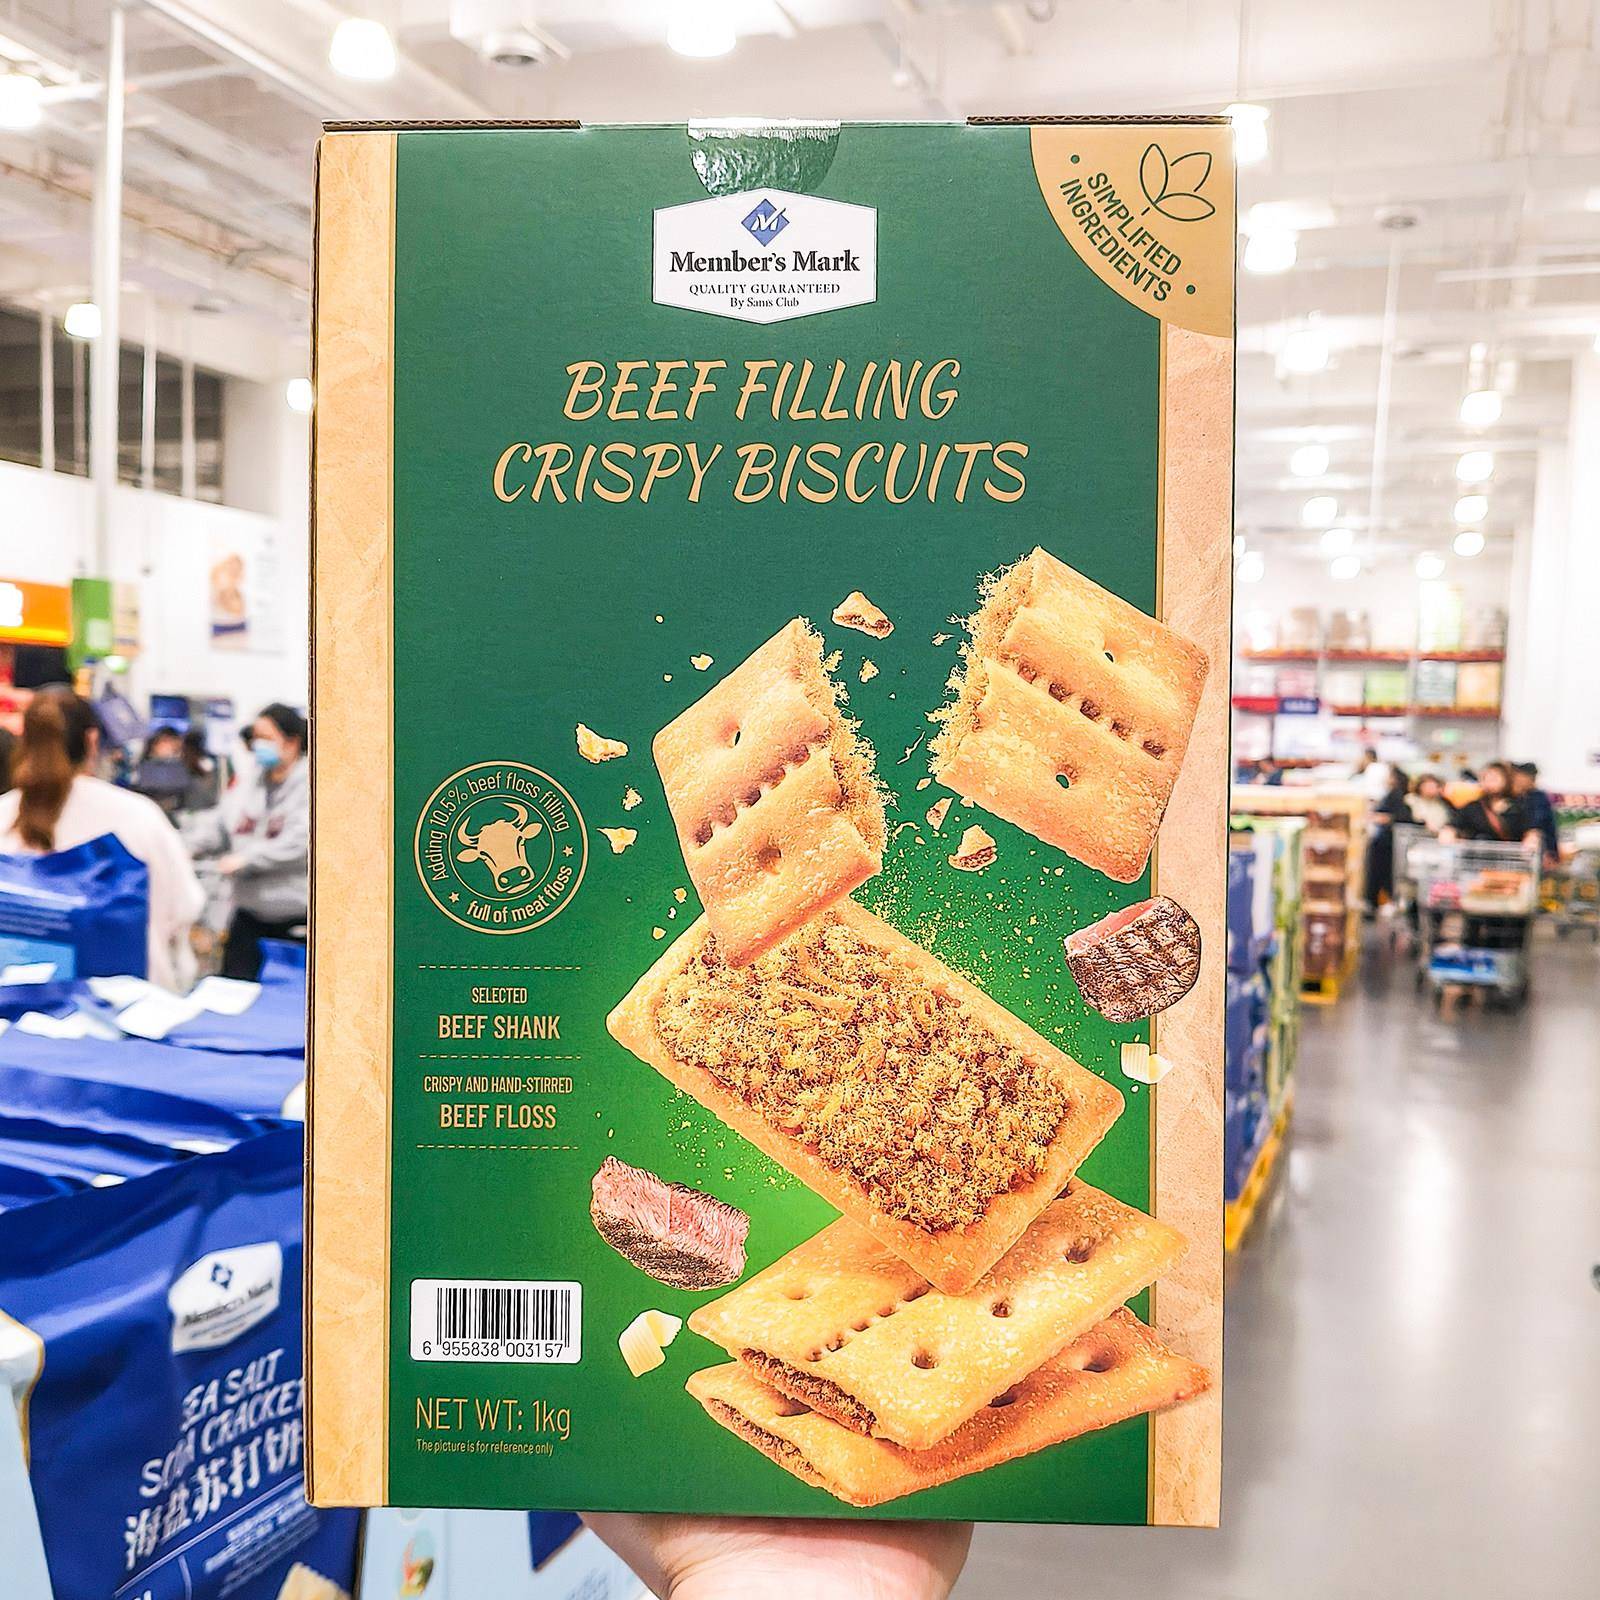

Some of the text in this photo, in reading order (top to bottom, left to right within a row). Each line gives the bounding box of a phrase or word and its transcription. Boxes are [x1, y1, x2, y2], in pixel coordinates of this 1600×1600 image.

[1088, 173, 1182, 275] SIMPLIFIED
[1060, 178, 1172, 302] INGREDIENTS
[670, 250, 860, 272] Member's Mark
[689, 283, 840, 295] QUALITY GUARANTEED
[730, 297, 745, 310] By
[776, 297, 799, 307] Club
[564, 360, 960, 420] BEEF FILLING
[494, 442, 1028, 503] CRISPY BISCUITS
[425, 772, 570, 881] Adding 10.5% beef floss filling
[466, 865, 573, 923] full of meat floss
[472, 988, 527, 1003] SELECTED
[439, 1015, 560, 1039] BEEF SHANK
[425, 1077, 572, 1093] CRISPY AND HAND-STIRRED
[441, 1105, 556, 1128] BEEF FLOSS
[423, 1341, 563, 1358] 6 955838 003157
[223, 1348, 285, 1404] SALT
[417, 1398, 569, 1440] NET WT: 1kg
[417, 1439, 554, 1457] The picture is for reference only
